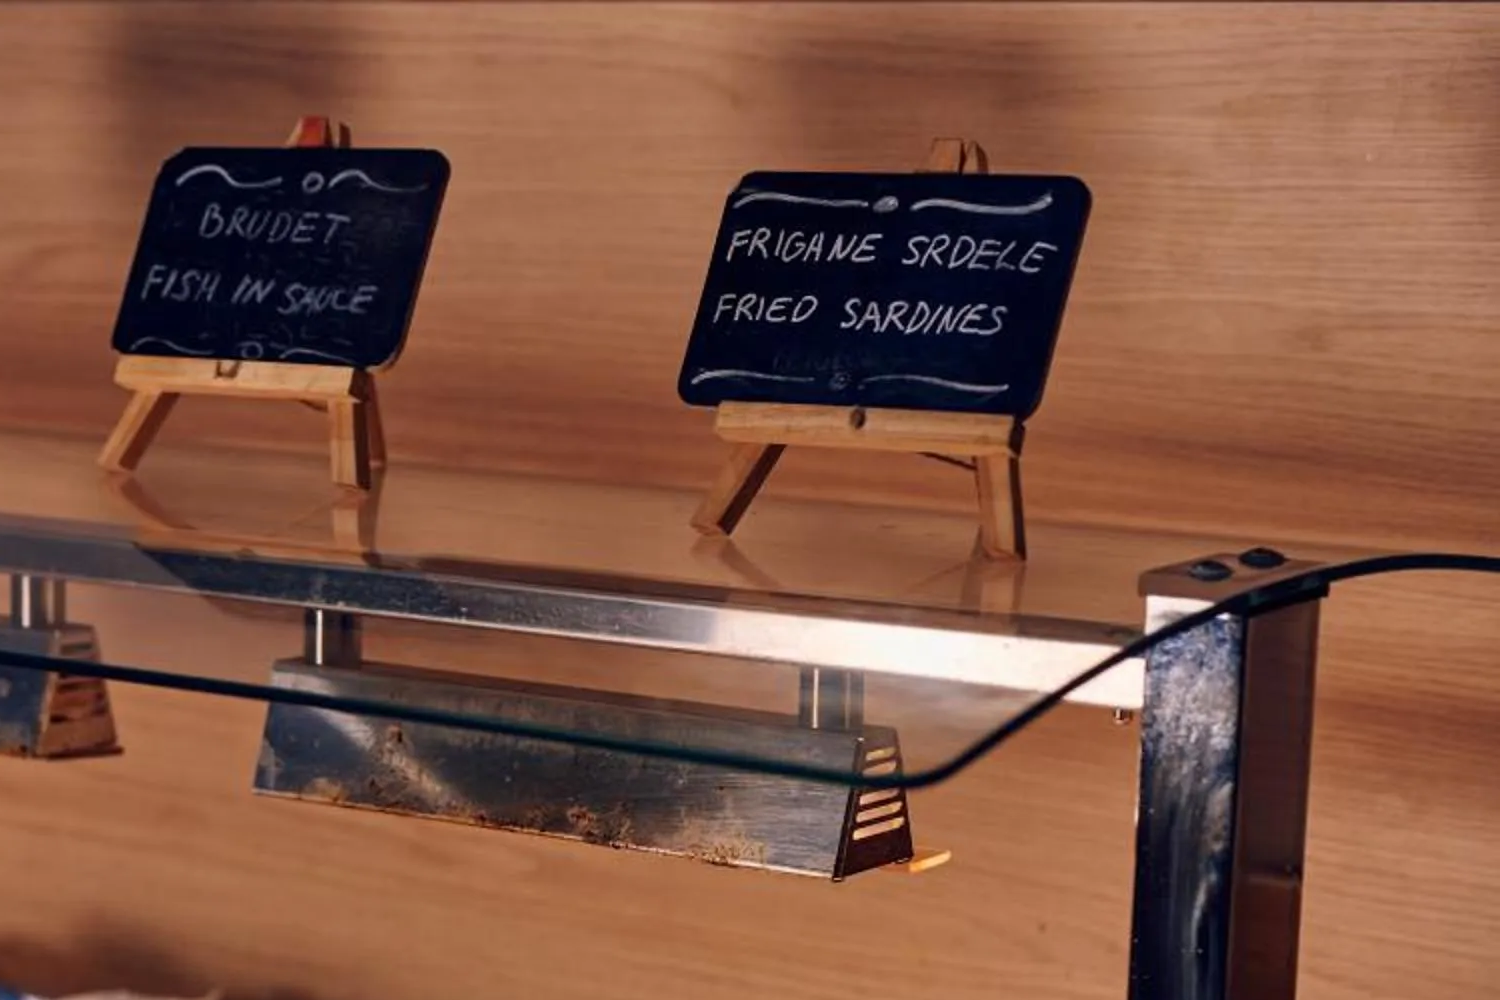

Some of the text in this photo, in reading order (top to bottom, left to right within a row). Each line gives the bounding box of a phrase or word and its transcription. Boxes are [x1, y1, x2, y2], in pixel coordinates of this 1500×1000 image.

[199, 202, 350, 244] BRUDET
[726, 226, 1058, 274] FRIGANE SRDELE
[141, 264, 379, 316] FISH IN SAUCE
[712, 293, 1009, 336] FRIED SARDINES
